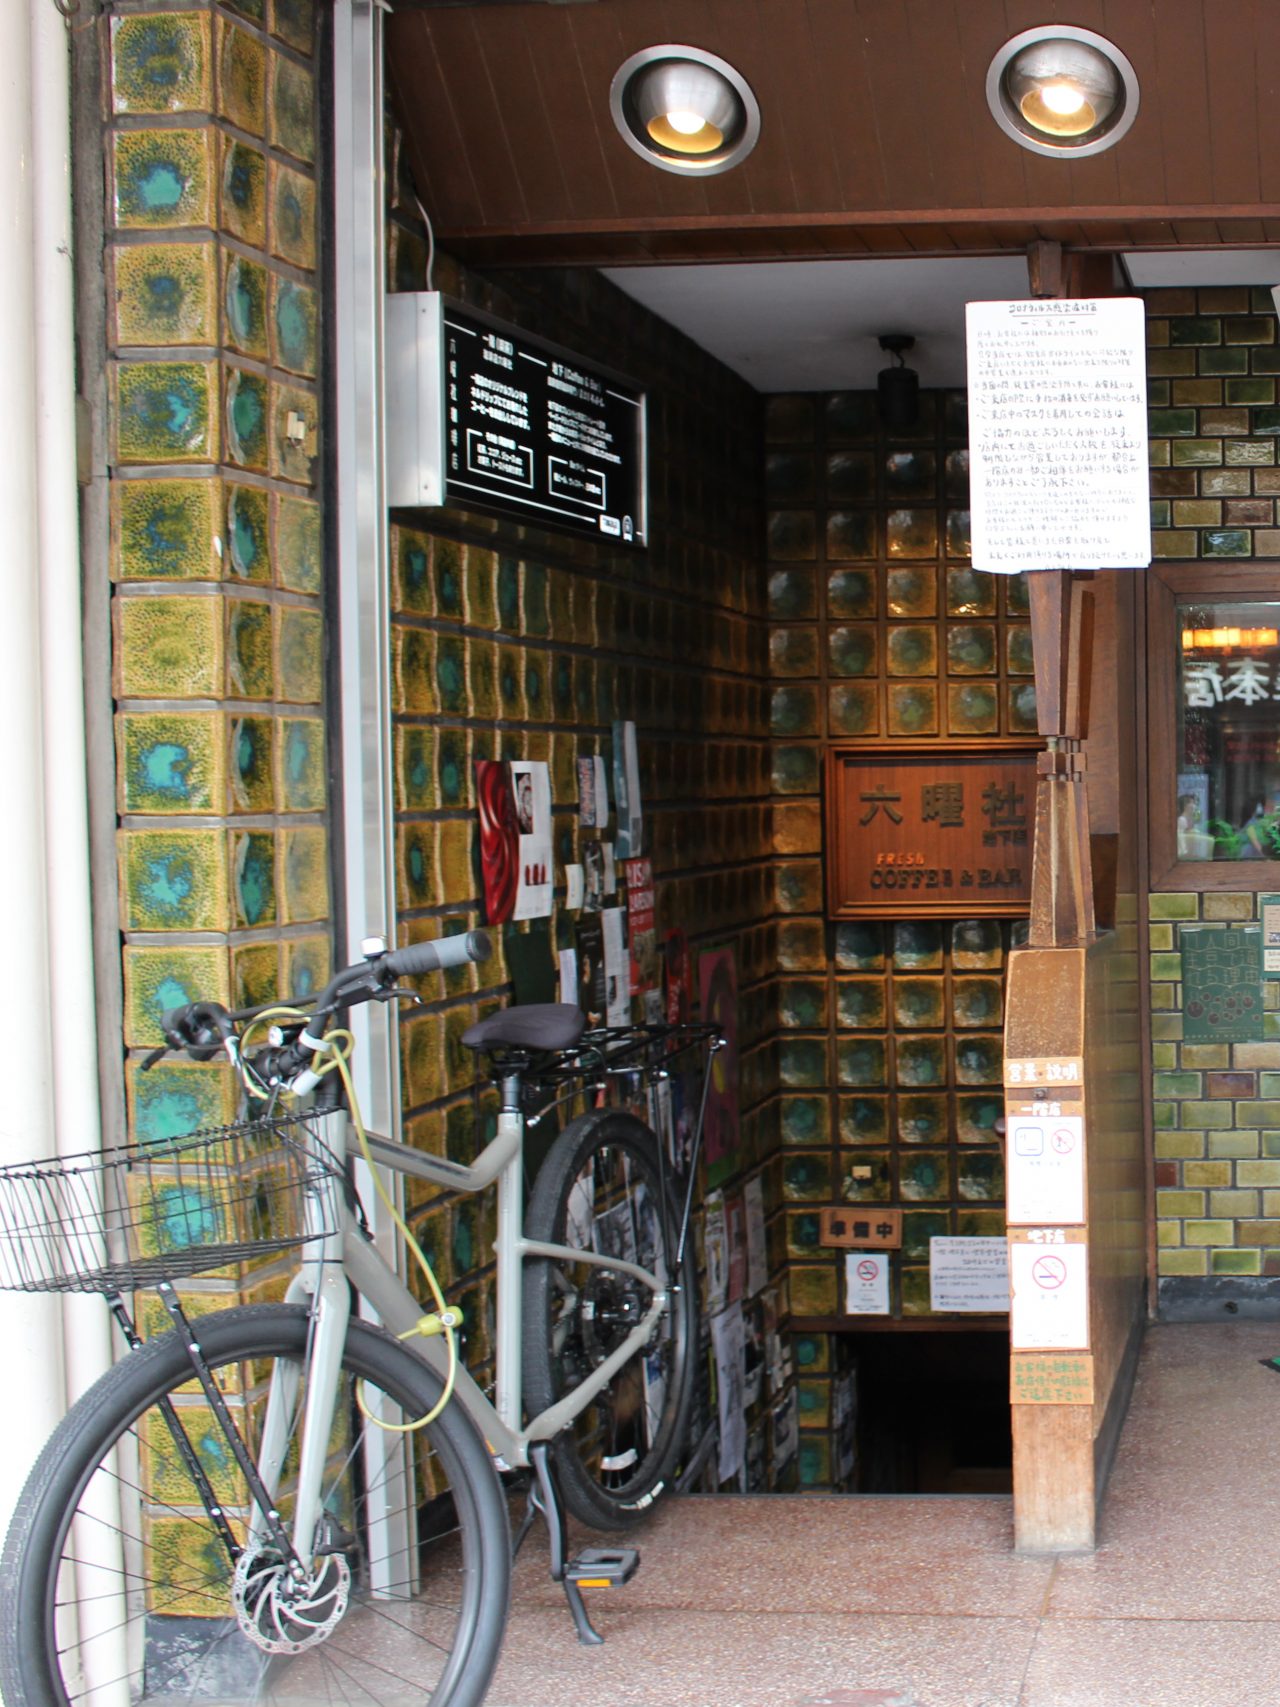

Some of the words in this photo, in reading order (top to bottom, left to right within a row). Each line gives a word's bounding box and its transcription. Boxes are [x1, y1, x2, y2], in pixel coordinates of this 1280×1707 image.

[859, 781, 1027, 828] 六曜社
[869, 870, 953, 890] COFFEE
[960, 870, 974, 887] &
